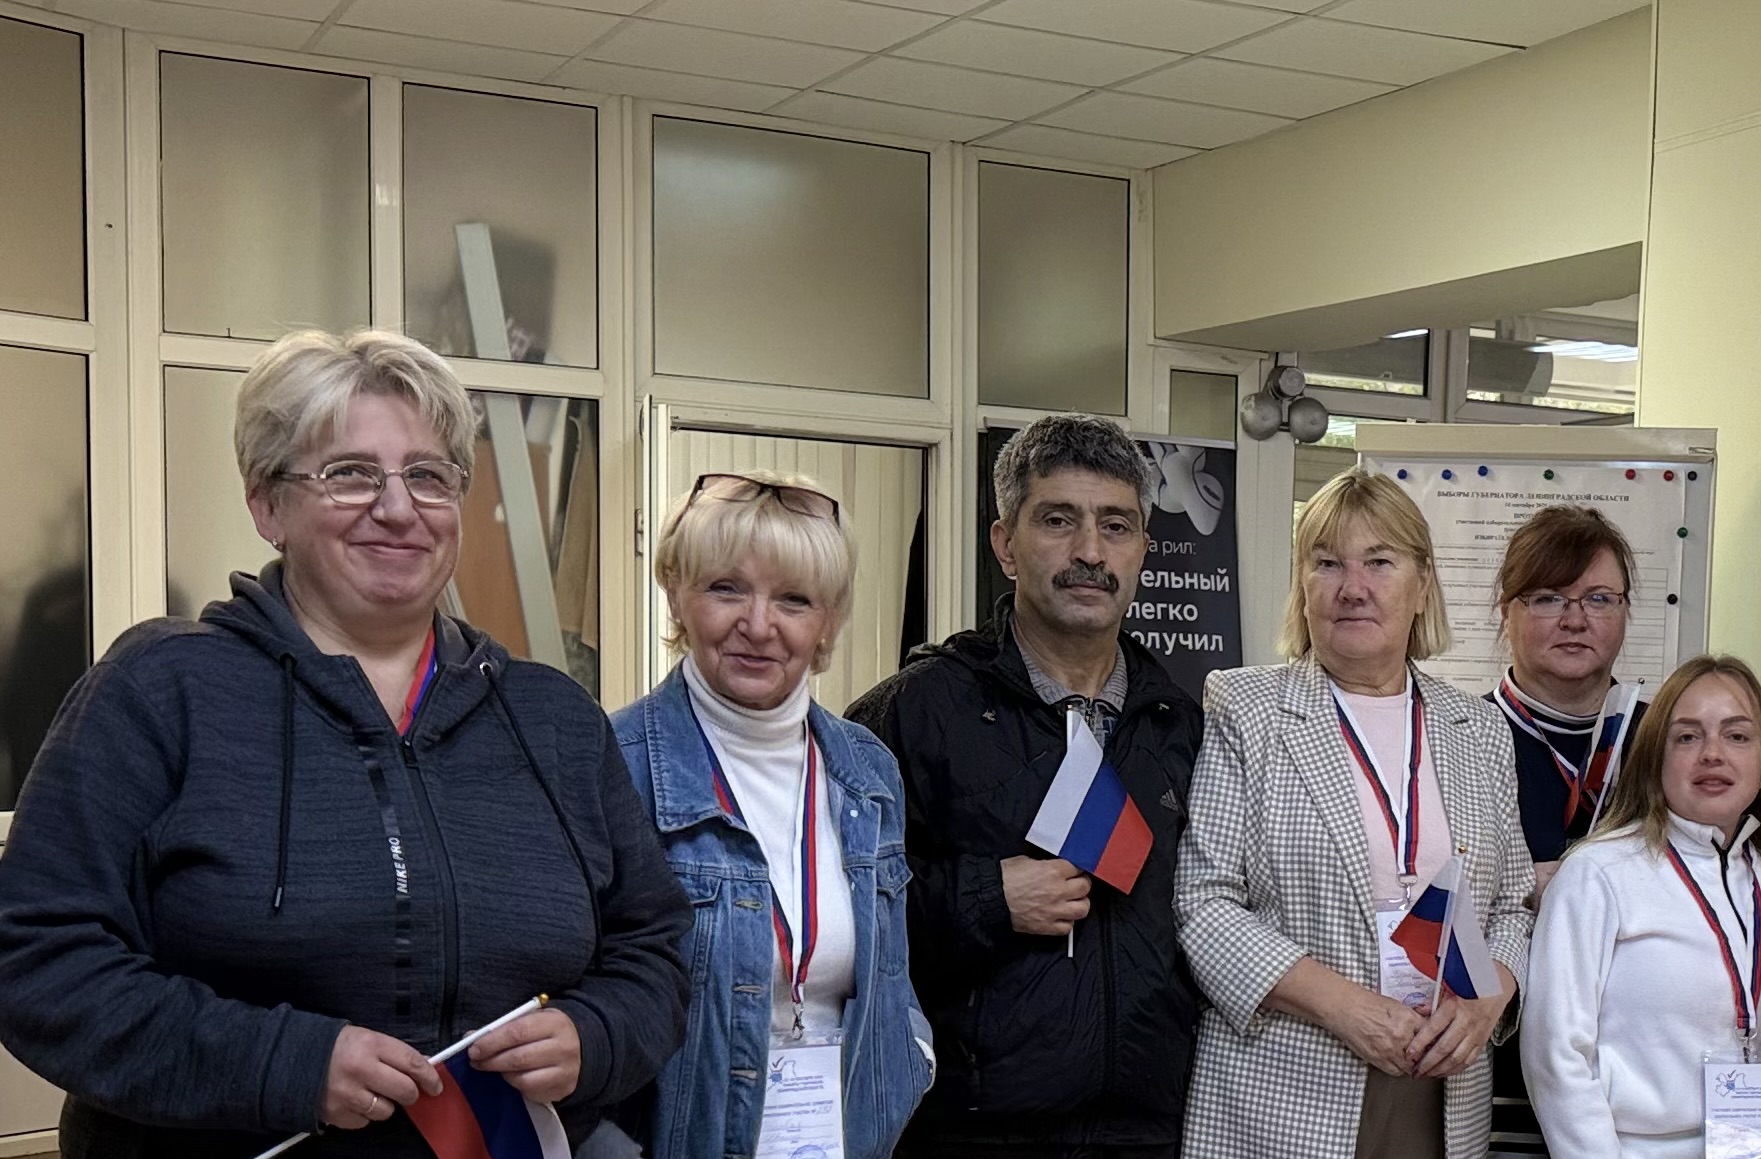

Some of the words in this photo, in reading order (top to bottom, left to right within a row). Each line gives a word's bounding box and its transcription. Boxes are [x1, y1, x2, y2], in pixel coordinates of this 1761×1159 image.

[1162, 541, 1197, 557] рил:
[1139, 567, 1230, 593] ельный
[1125, 601, 1199, 622] легко
[1124, 629, 1224, 656] олучил
[393, 861, 408, 893] NIKE
